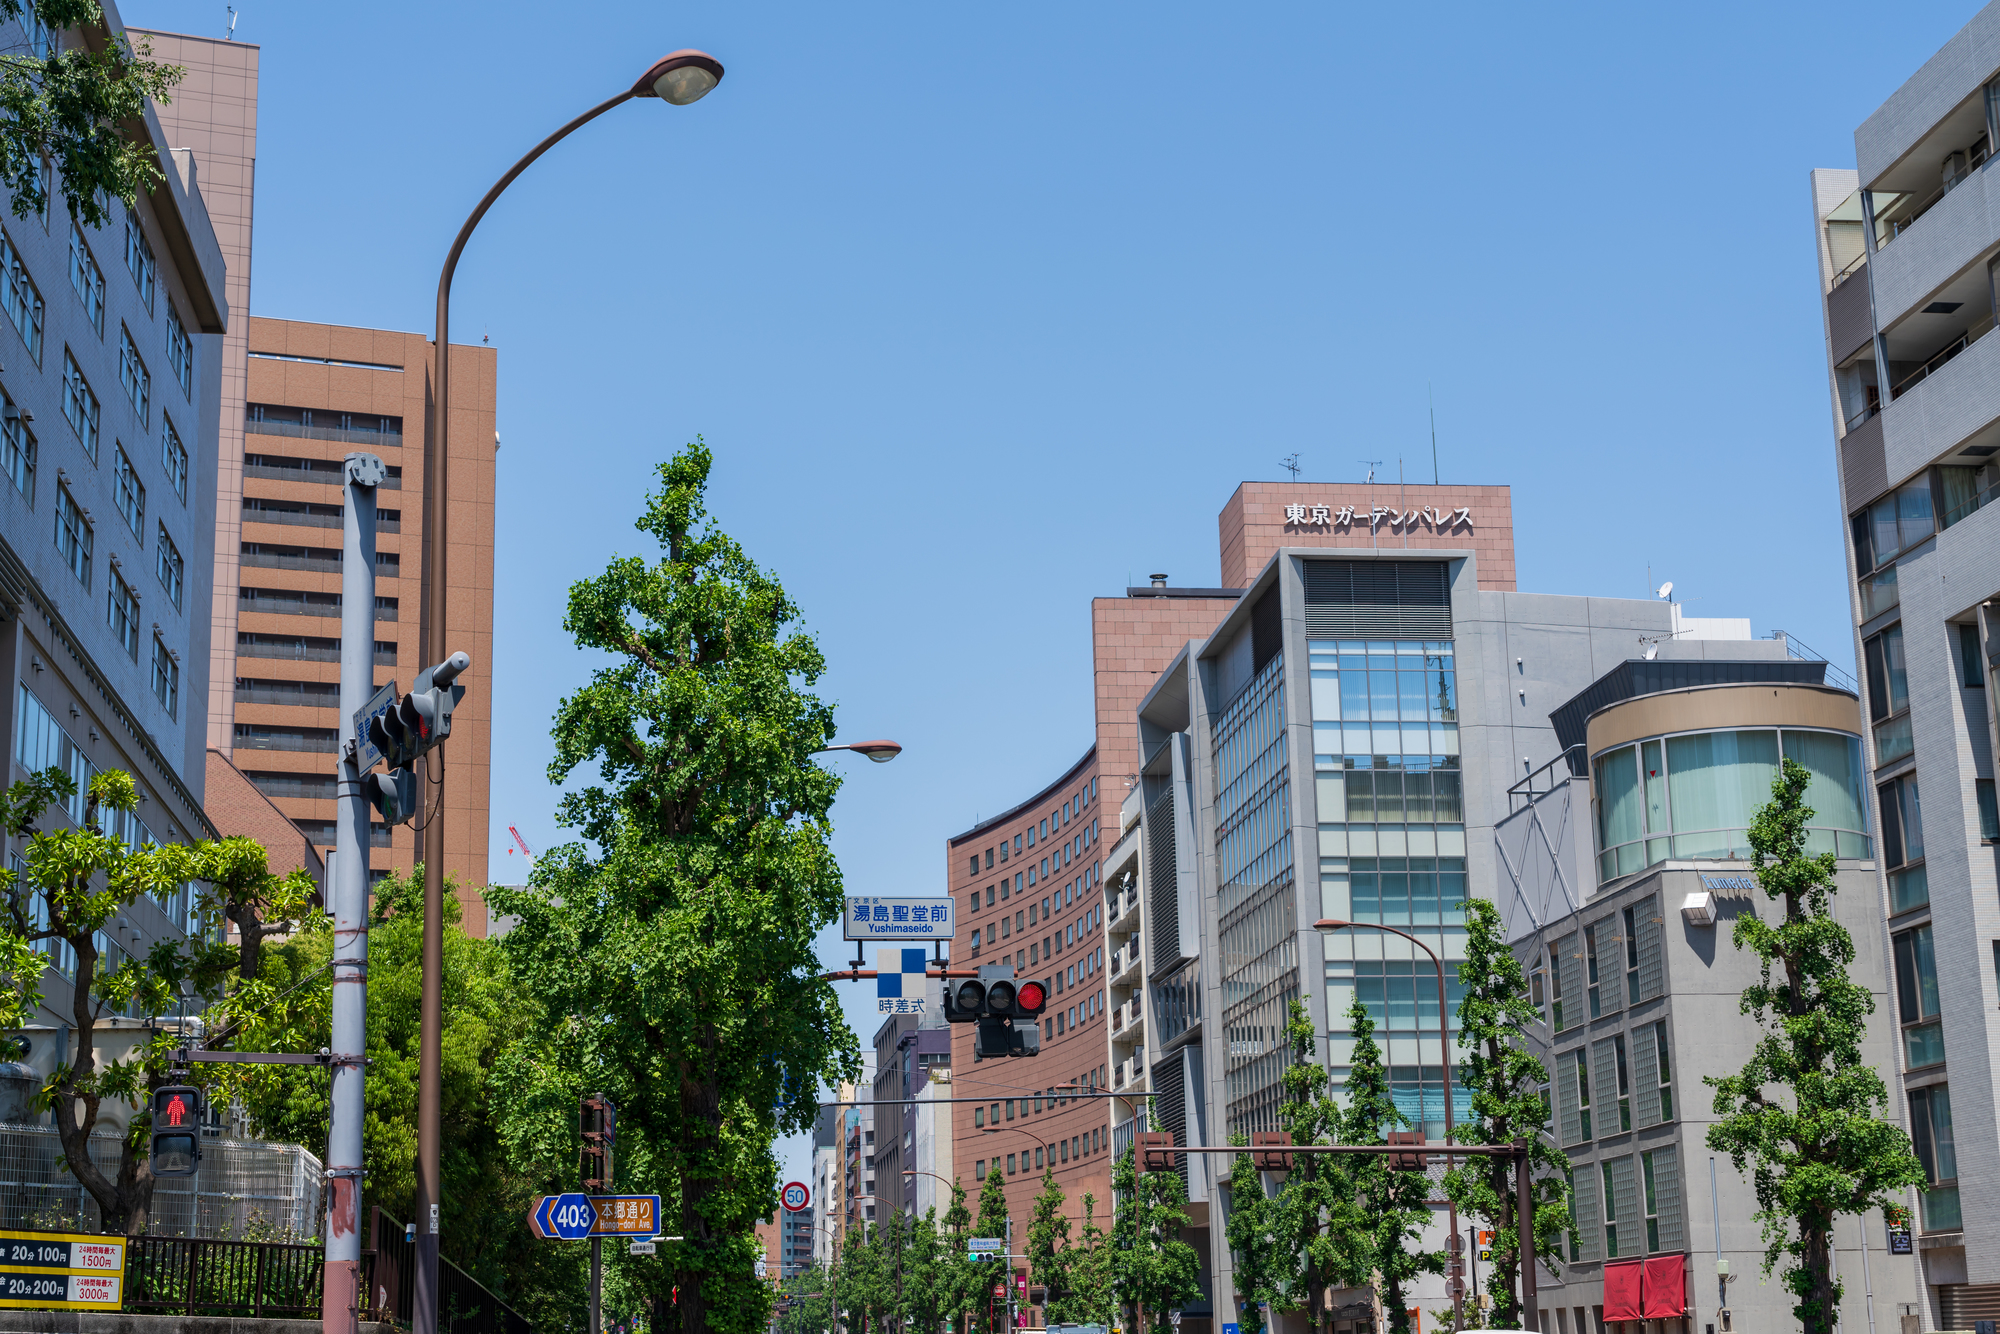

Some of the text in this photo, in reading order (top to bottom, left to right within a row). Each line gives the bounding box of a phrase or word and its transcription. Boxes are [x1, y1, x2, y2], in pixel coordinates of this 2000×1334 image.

[1284, 502, 1474, 526] 東京ガーデンパレス
[853, 905, 948, 922] 湯島聖堂前
[868, 923, 934, 933] Yushimaseido
[878, 998, 925, 1014] 時差式
[787, 1190, 804, 1203] 50
[557, 1204, 590, 1228] 403
[601, 1201, 650, 1219] 本郷通り
[600, 1219, 652, 1231] Hongo-dori Ave.
[82, 1255, 112, 1268] 1500円
[1482, 1251, 1490, 1261] P
[79, 1288, 109, 1300] 3000円
